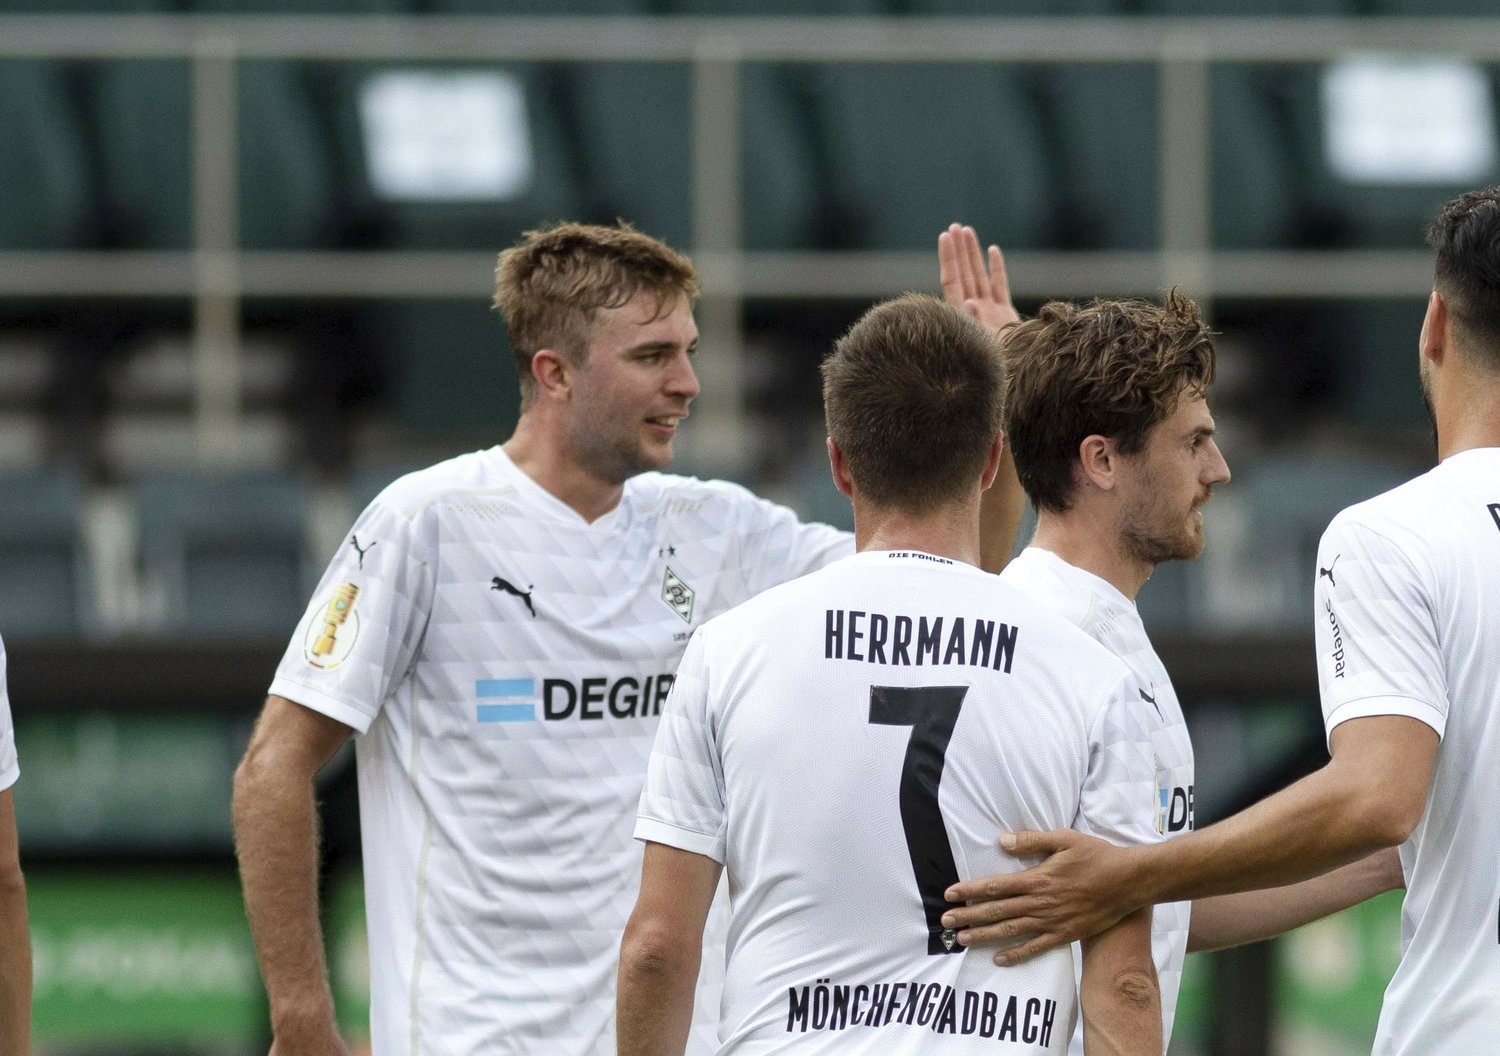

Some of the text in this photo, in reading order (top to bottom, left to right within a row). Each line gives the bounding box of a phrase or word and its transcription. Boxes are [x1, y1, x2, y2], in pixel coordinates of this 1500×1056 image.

[911, 553, 954, 565] FOHLEN
[824, 609, 1019, 674] HERRMANN
[868, 684, 970, 956] 7
